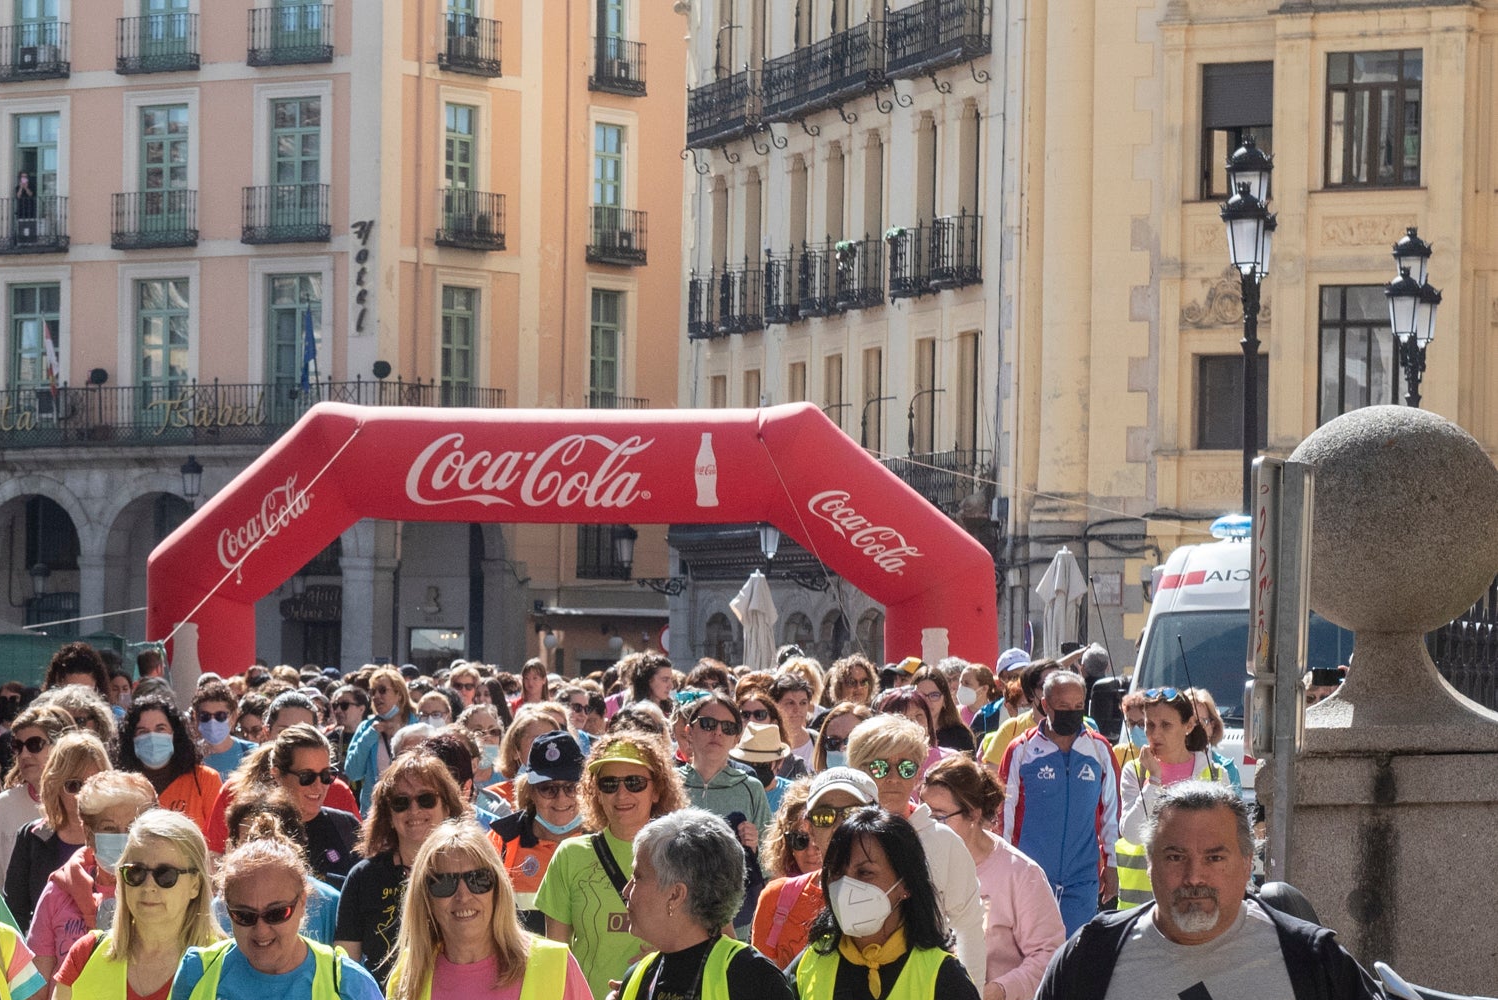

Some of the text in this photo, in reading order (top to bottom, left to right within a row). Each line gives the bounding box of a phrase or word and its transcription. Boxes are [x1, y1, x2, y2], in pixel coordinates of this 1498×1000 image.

[351, 220, 374, 333] Hotel
[406, 433, 655, 508] Coca-Cola
[217, 471, 310, 569] Coca-Cola
[808, 490, 924, 573] Coca-Cola
[1037, 771, 1056, 780] CCM
